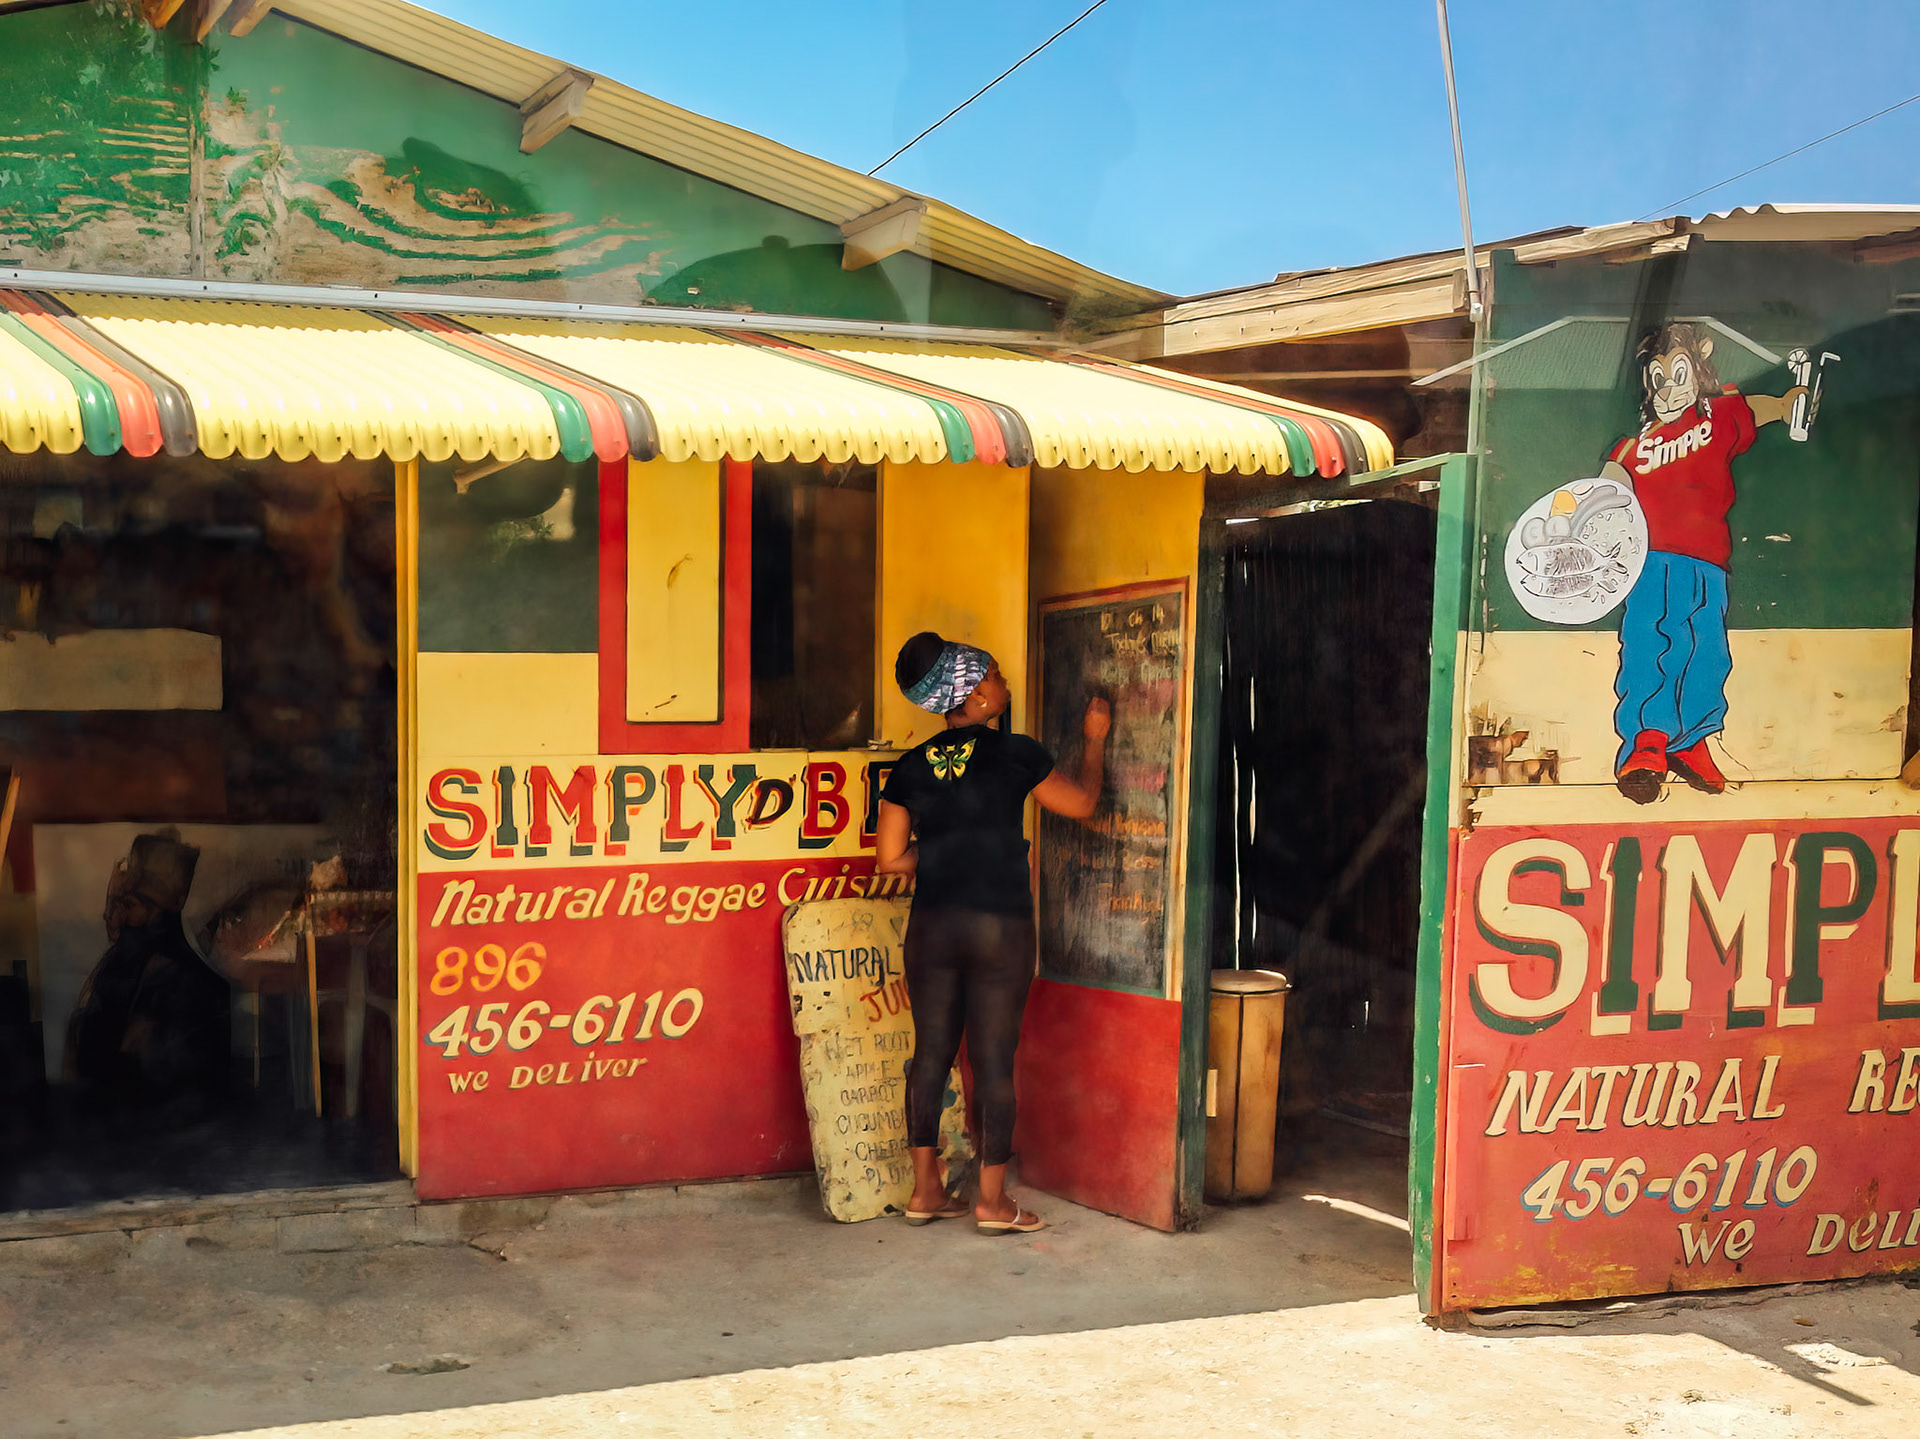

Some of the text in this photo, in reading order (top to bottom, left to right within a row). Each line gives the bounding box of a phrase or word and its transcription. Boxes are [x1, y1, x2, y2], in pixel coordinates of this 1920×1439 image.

[1635, 421, 1713, 475] Simple
[424, 764, 756, 861] SIMPLY
[617, 872, 766, 925] Reggae
[777, 863, 916, 906] Cuisin
[430, 941, 547, 996] 896
[794, 946, 901, 984] NATURAL
[424, 987, 704, 1059] 456-6110
[1485, 1046, 1920, 1137] NATURAL RE
[1520, 1145, 1818, 1222] 456-6110
